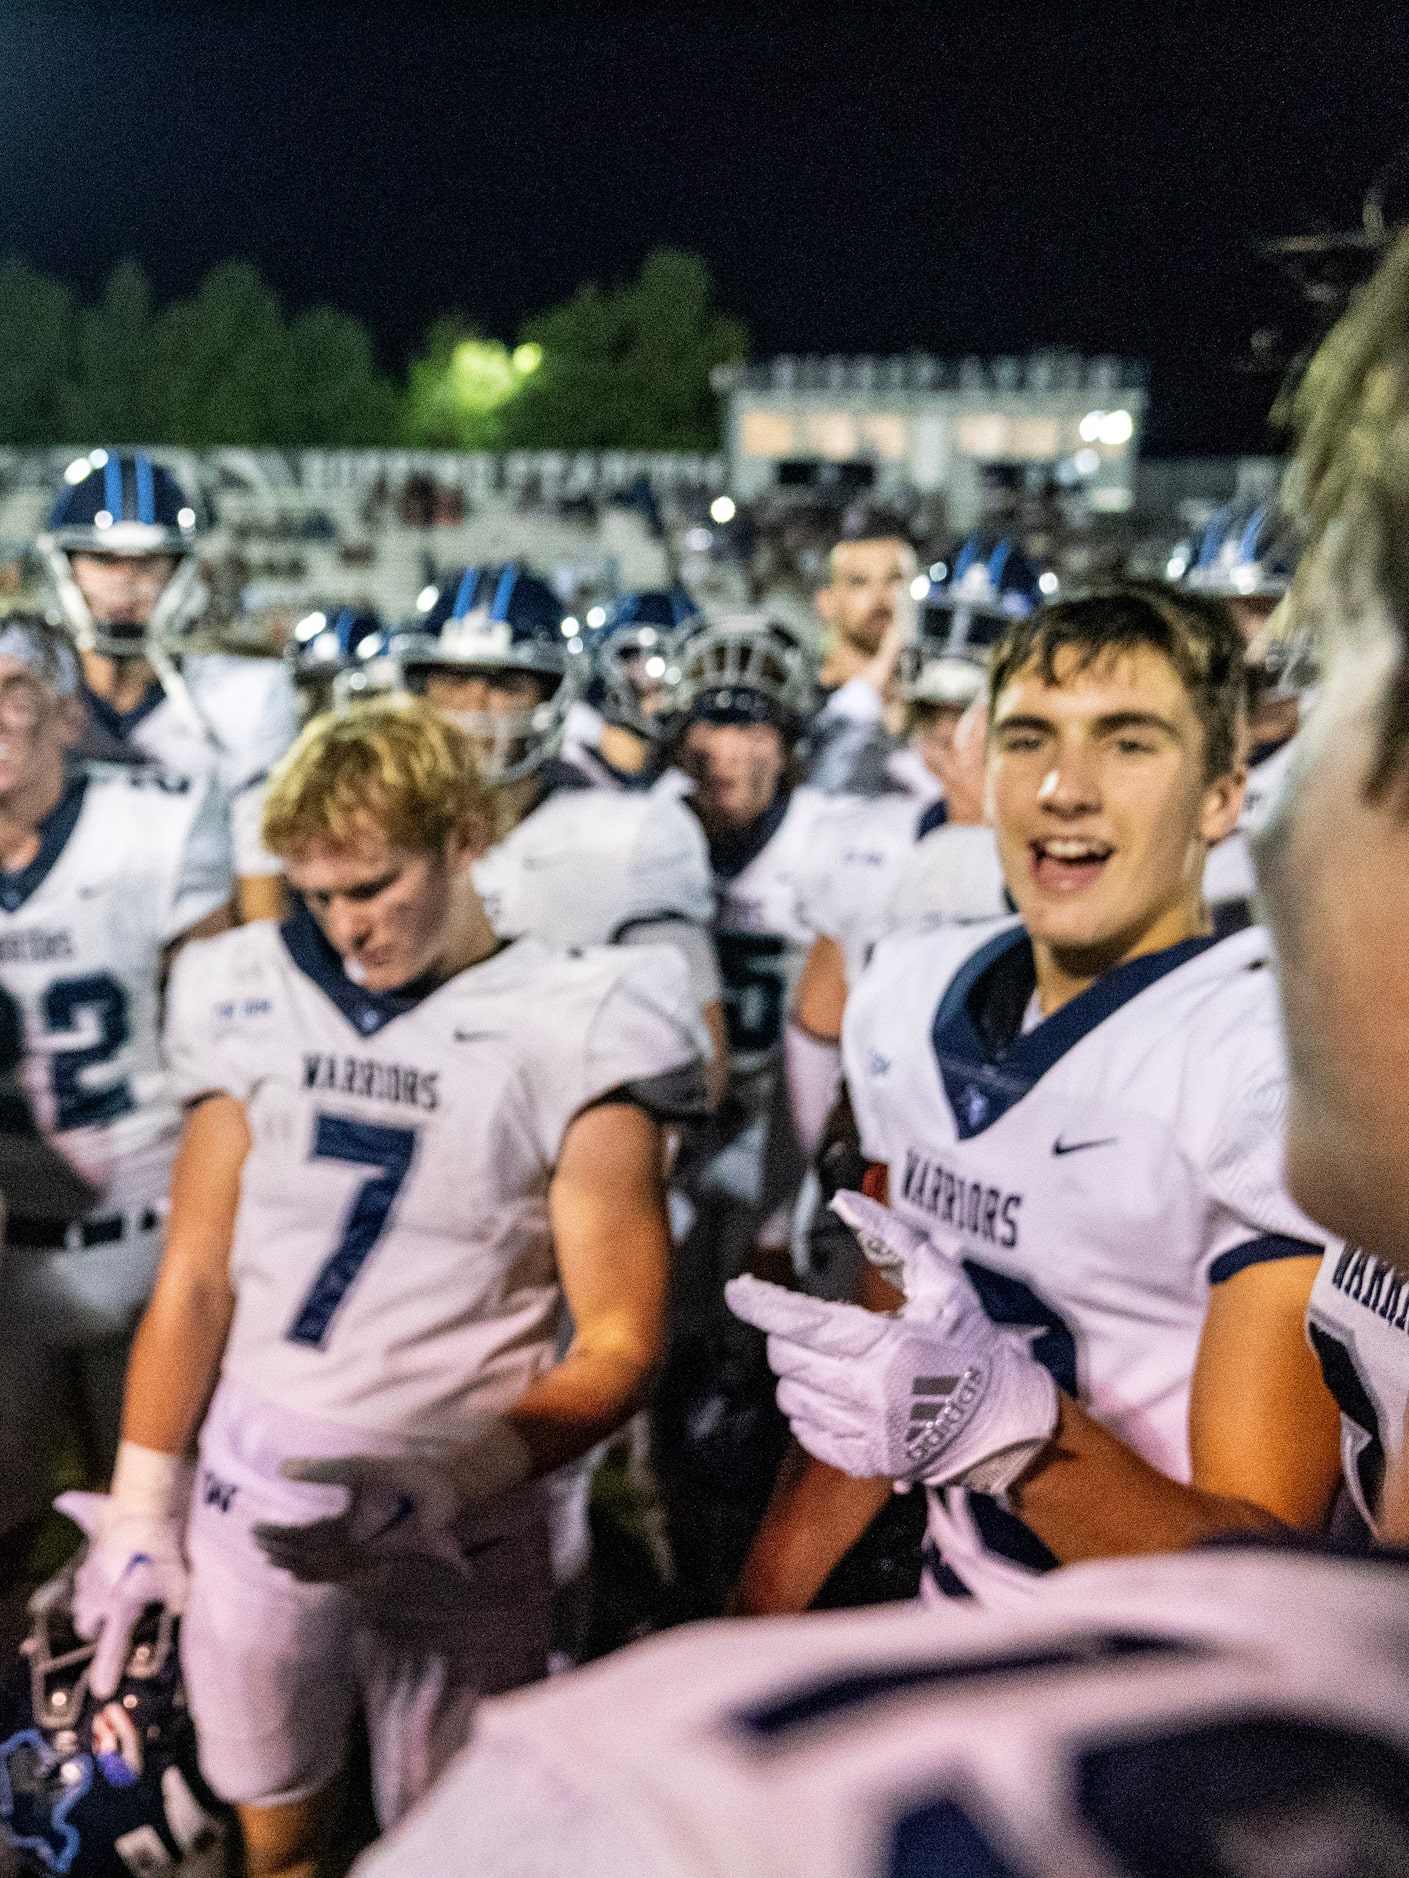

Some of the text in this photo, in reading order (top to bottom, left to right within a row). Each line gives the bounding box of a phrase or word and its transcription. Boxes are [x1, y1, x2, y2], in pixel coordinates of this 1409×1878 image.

[303, 1053, 439, 1112] WARRIORS
[286, 1107, 421, 1350] 7
[902, 1149, 1022, 1248] WARRIORS
